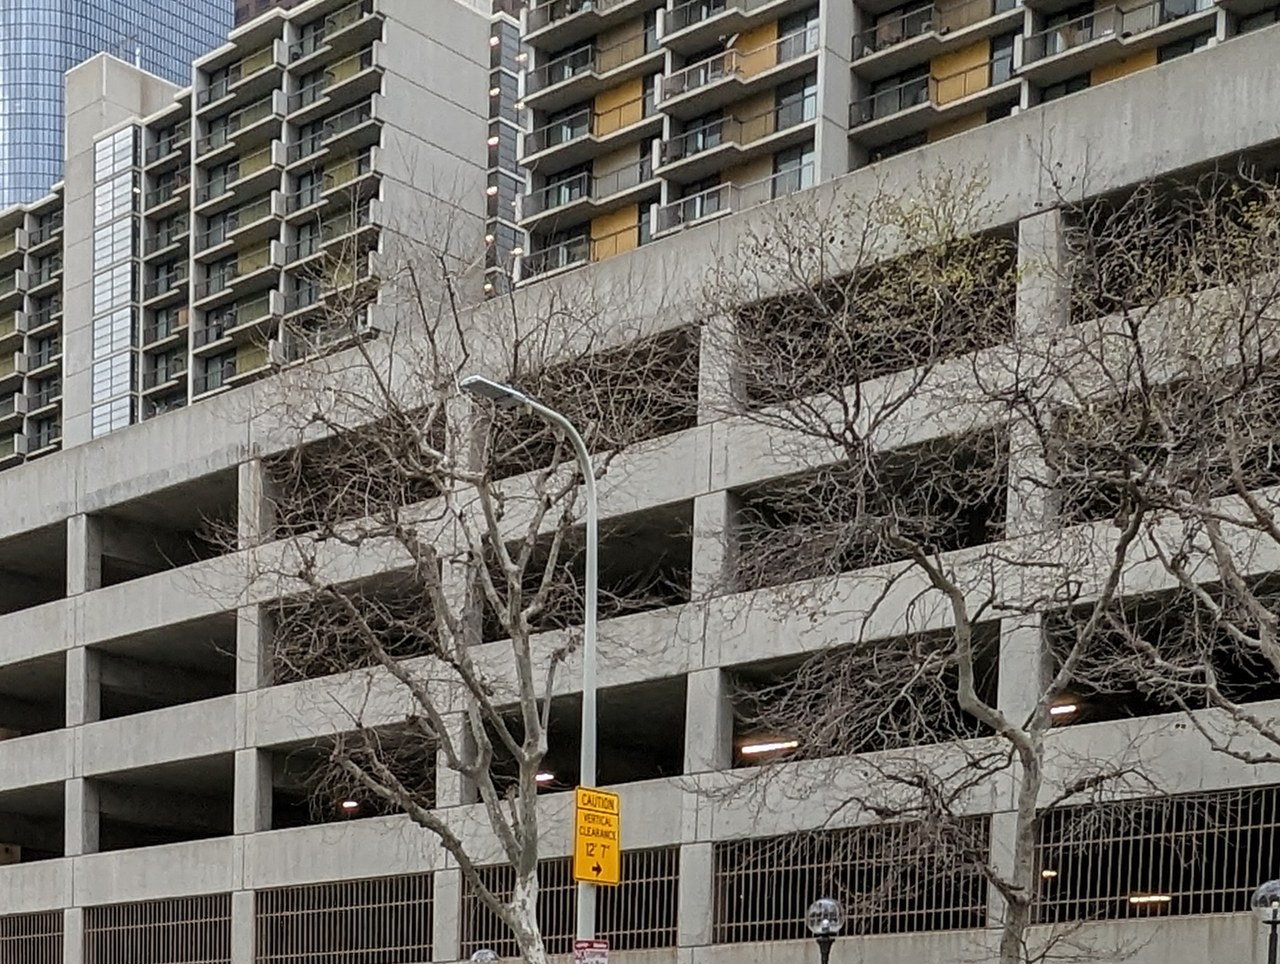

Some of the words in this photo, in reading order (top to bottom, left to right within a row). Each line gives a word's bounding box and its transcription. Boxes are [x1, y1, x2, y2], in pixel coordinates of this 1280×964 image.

[581, 793, 615, 810] CAUTION
[583, 813, 613, 828] VERTICAL
[579, 825, 617, 841] CLEARANCE
